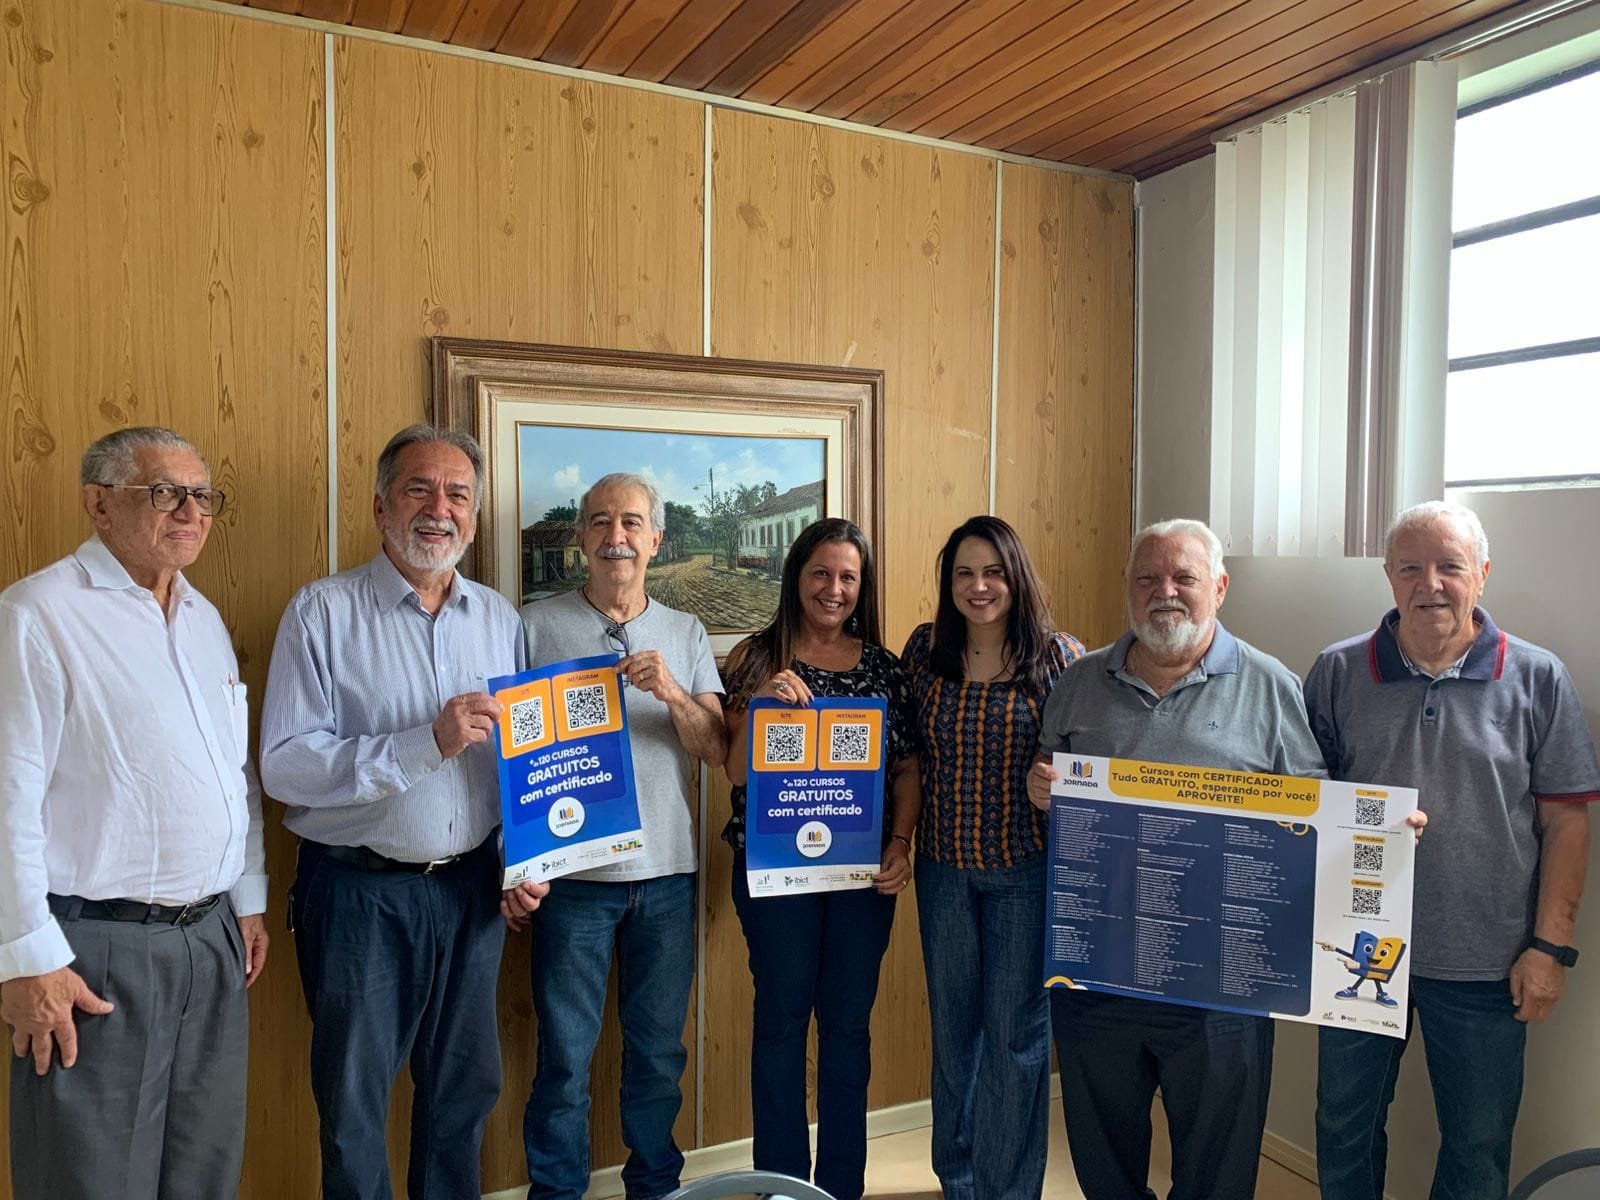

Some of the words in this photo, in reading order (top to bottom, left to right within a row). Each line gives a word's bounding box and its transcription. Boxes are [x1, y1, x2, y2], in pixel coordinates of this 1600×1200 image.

[551, 745, 589, 760] CURSOS
[527, 756, 600, 785] GRATUITOS
[1139, 765, 1175, 777] Cursos
[1177, 770, 1200, 779] com
[1203, 772, 1283, 788] CERTIFICADO!
[520, 789, 544, 804] com
[545, 770, 612, 795] certificado
[793, 778, 808, 787] 120
[809, 777, 846, 787] CURSOS
[1062, 778, 1098, 788] JORNADA
[1112, 772, 1138, 783] Tudo
[1140, 775, 1199, 790] GRATUITO,
[1202, 781, 1260, 796] esperando
[1263, 790, 1282, 799] por
[1285, 791, 1316, 802] você!
[778, 789, 854, 802] GRATUITOS
[1176, 789, 1244, 804] APROVEITE!
[767, 807, 795, 817] com
[797, 803, 862, 816] certificado
